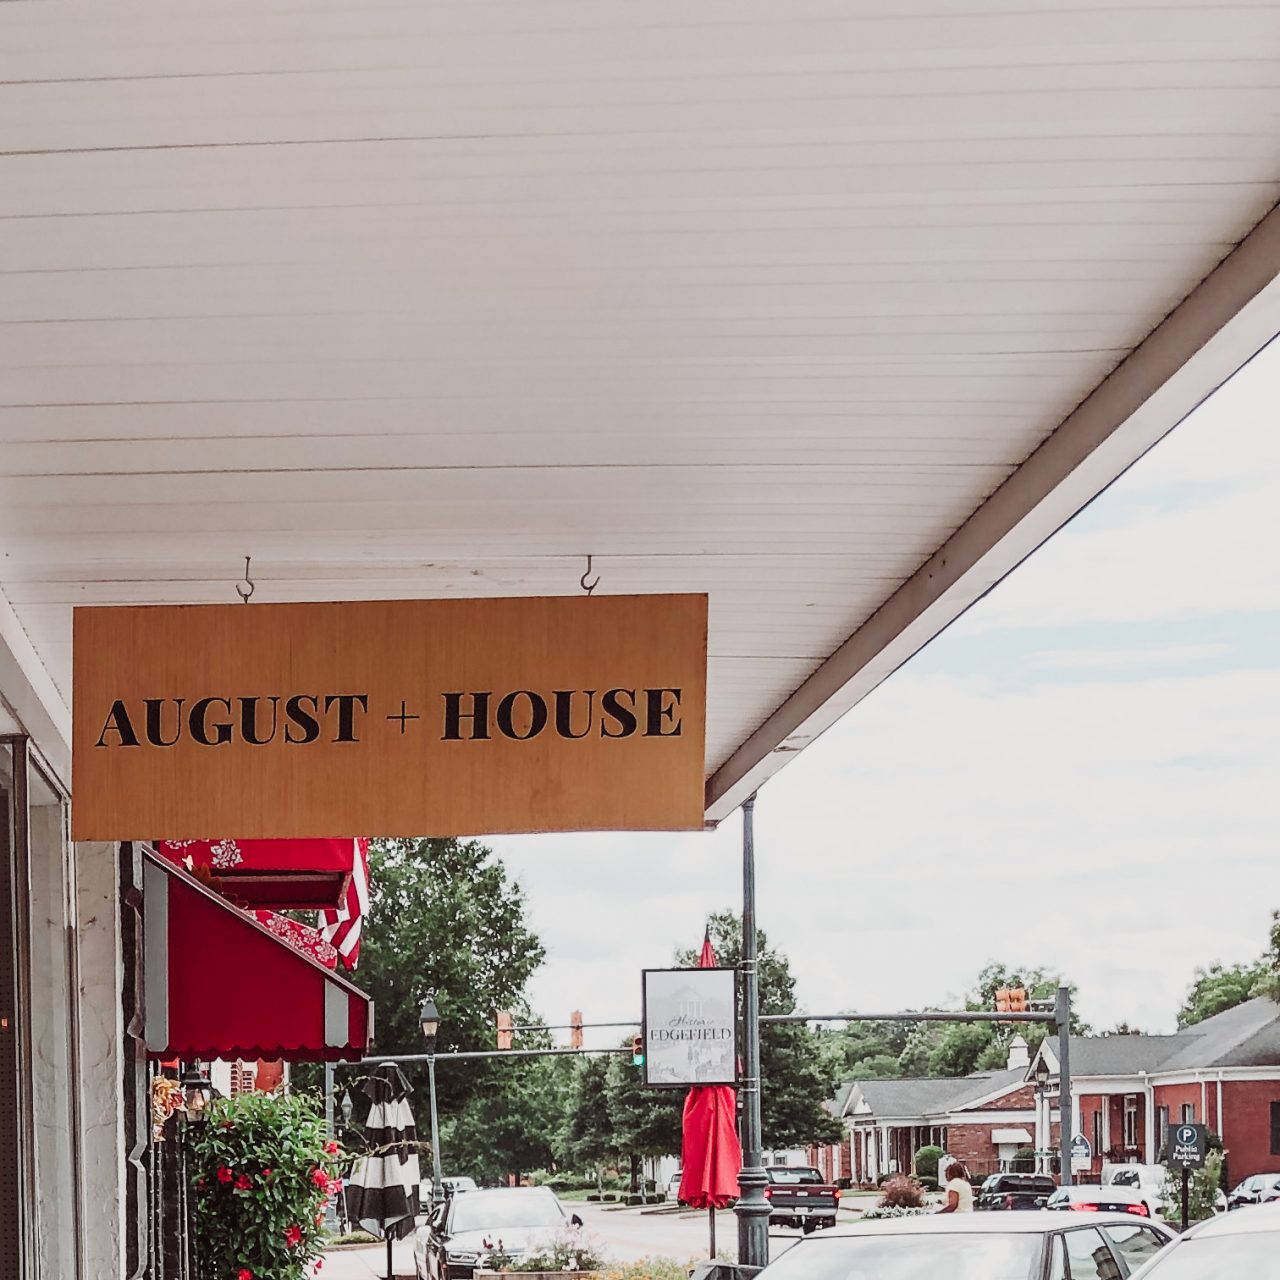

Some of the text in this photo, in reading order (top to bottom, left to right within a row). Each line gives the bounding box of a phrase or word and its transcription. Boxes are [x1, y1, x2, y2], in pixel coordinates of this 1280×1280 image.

[94, 687, 684, 748] AUGUST + HOUSE
[668, 1013, 714, 1027] Historic
[650, 1027, 732, 1041] EDGEFIELD
[1175, 1145, 1198, 1153] Public
[1172, 1153, 1201, 1162] Parking
